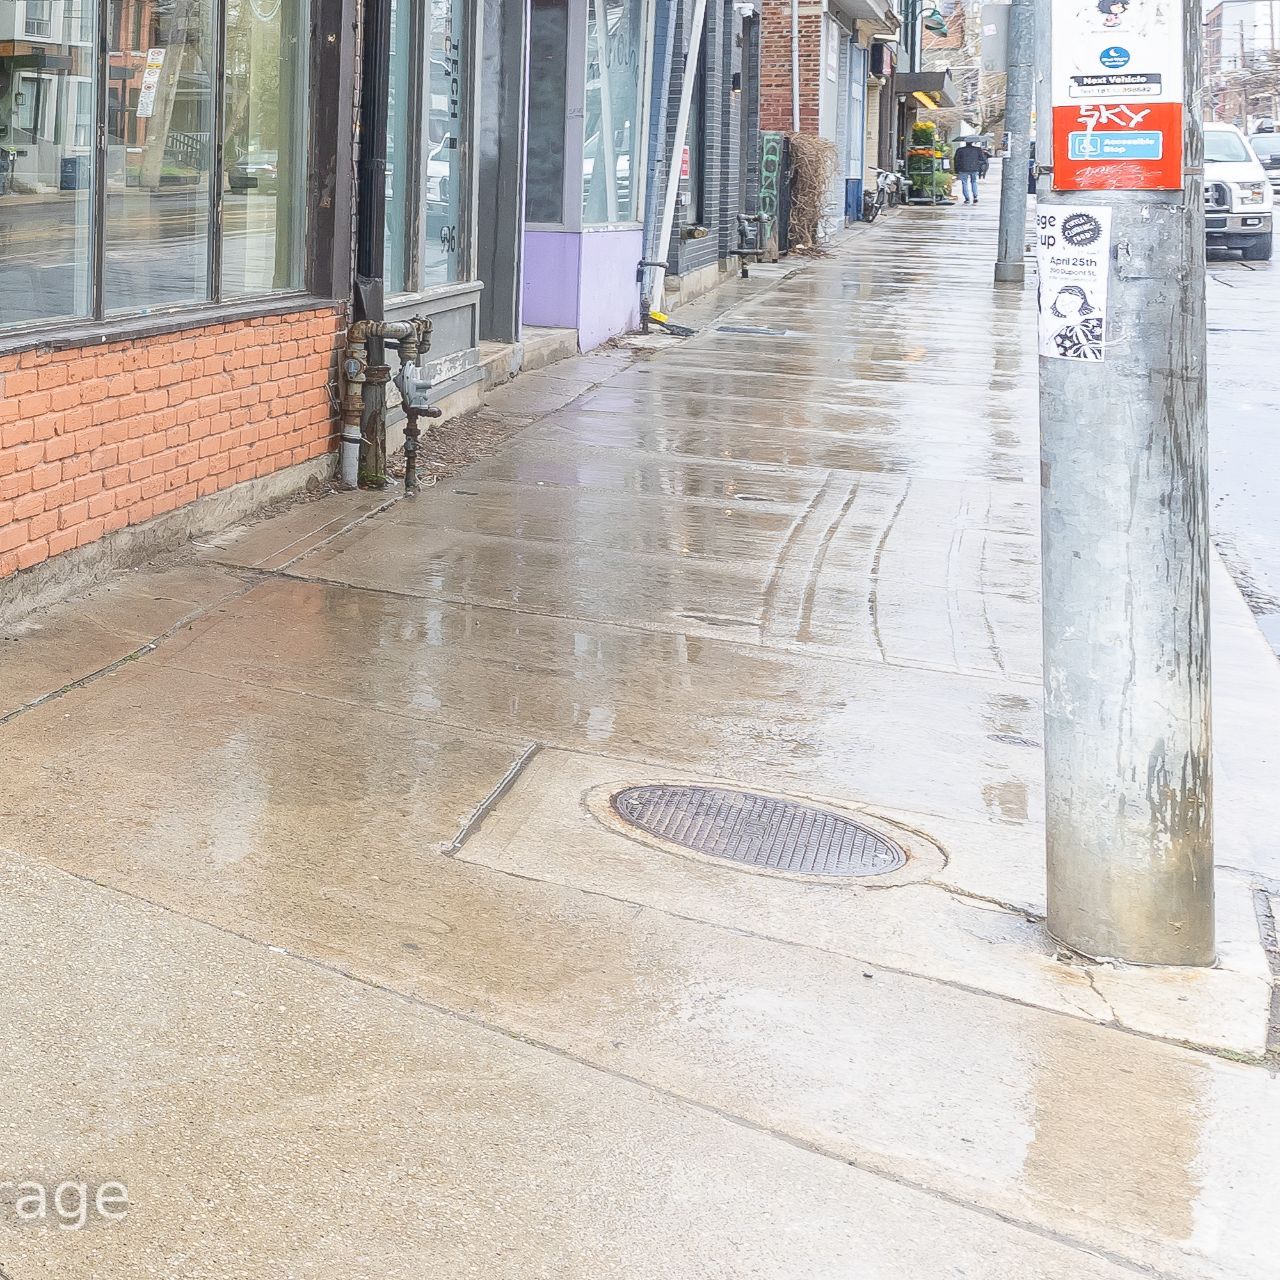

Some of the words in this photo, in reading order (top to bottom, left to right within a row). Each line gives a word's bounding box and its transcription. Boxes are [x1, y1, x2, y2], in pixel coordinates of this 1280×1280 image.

[450, 38, 460, 119] TECH
[1083, 76, 1108, 85] Next
[1108, 75, 1147, 84] Vehicle
[1049, 256, 1070, 266] April
[1072, 257, 1097, 267] 25th
